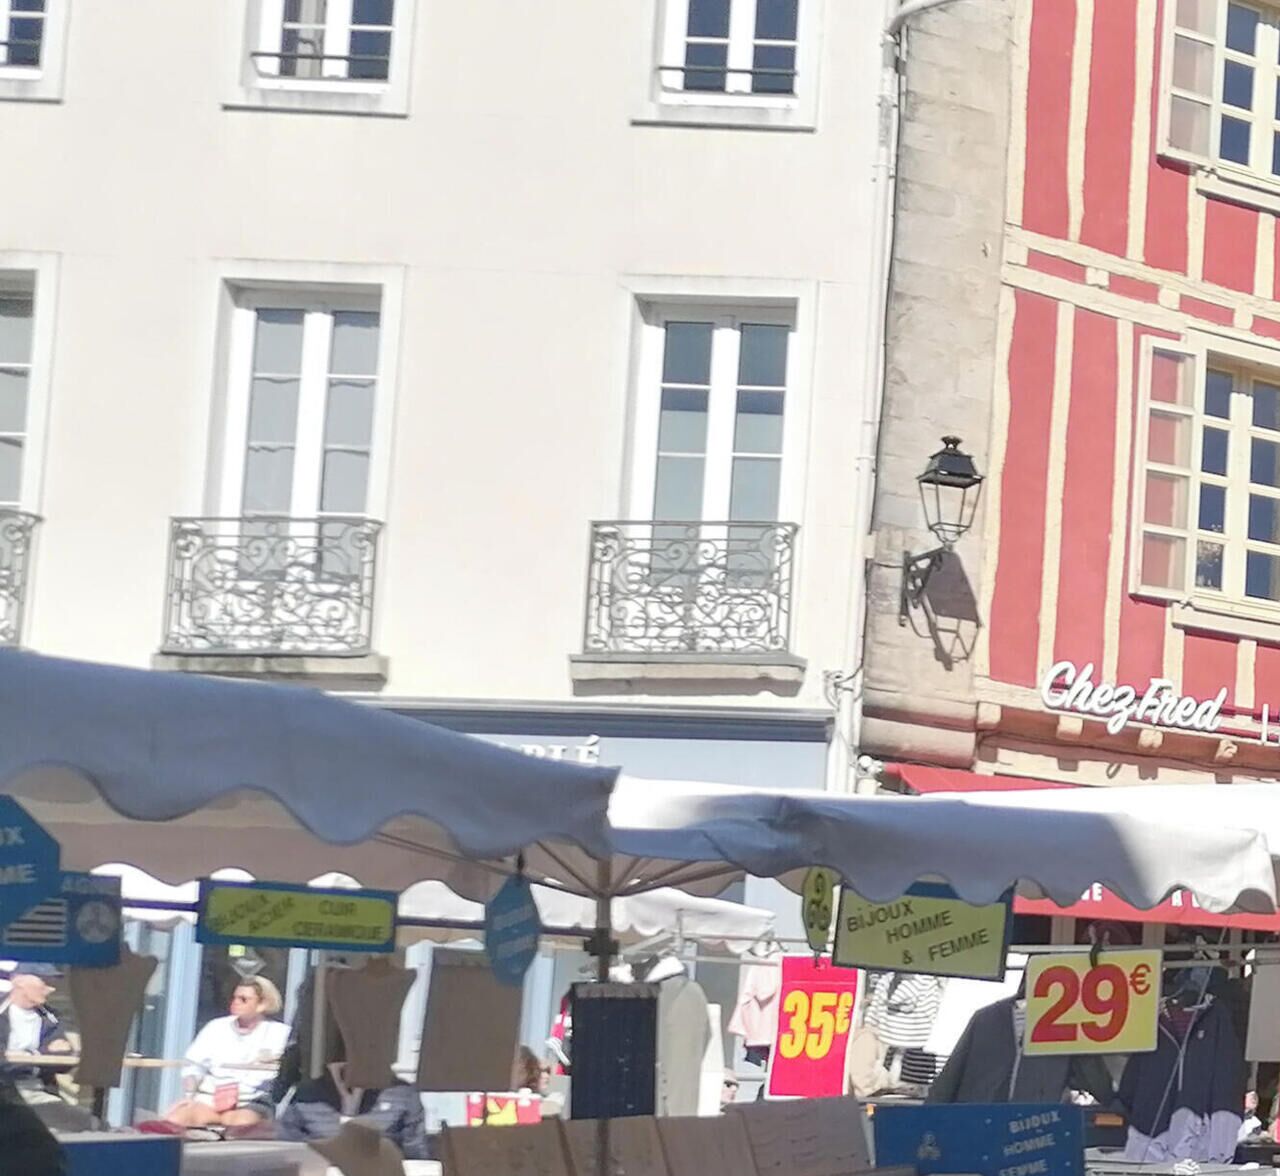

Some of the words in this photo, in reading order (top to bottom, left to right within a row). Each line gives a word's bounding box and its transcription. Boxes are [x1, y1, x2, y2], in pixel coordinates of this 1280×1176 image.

[1041, 660, 1136, 734] Chez
[1137, 677, 1229, 731] Fred
[885, 910, 953, 945] HOMME
[901, 950, 913, 965] &
[928, 928, 990, 962] FEMME
[1031, 962, 1152, 1045] 29€
[1008, 1110, 1061, 1134] BIJOUX
[1003, 1133, 1056, 1157] HOMME
